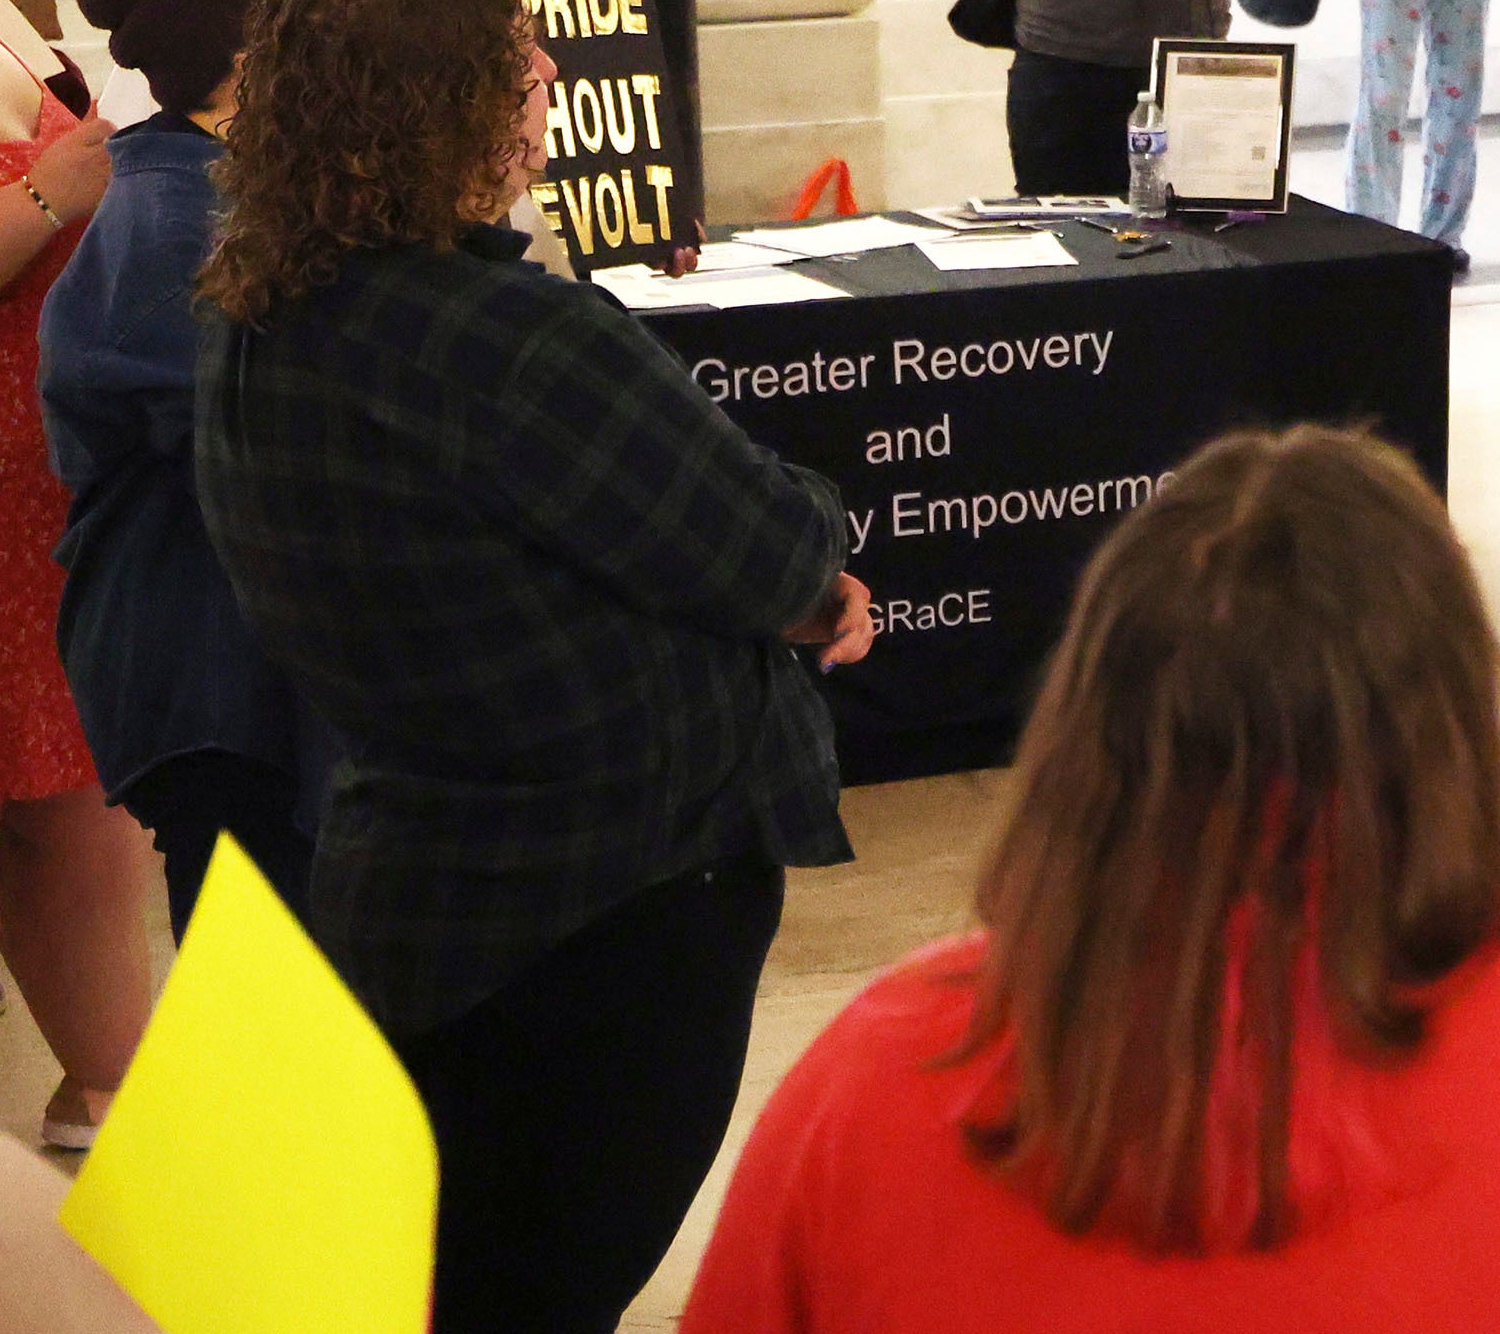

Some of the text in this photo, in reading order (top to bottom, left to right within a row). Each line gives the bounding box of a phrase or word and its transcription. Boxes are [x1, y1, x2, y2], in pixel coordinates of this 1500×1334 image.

[544, 75, 661, 158] HOUT
[530, 165, 674, 255] EVOLT
[692, 330, 1114, 403] Greater Recovery
[866, 413, 951, 464] and
